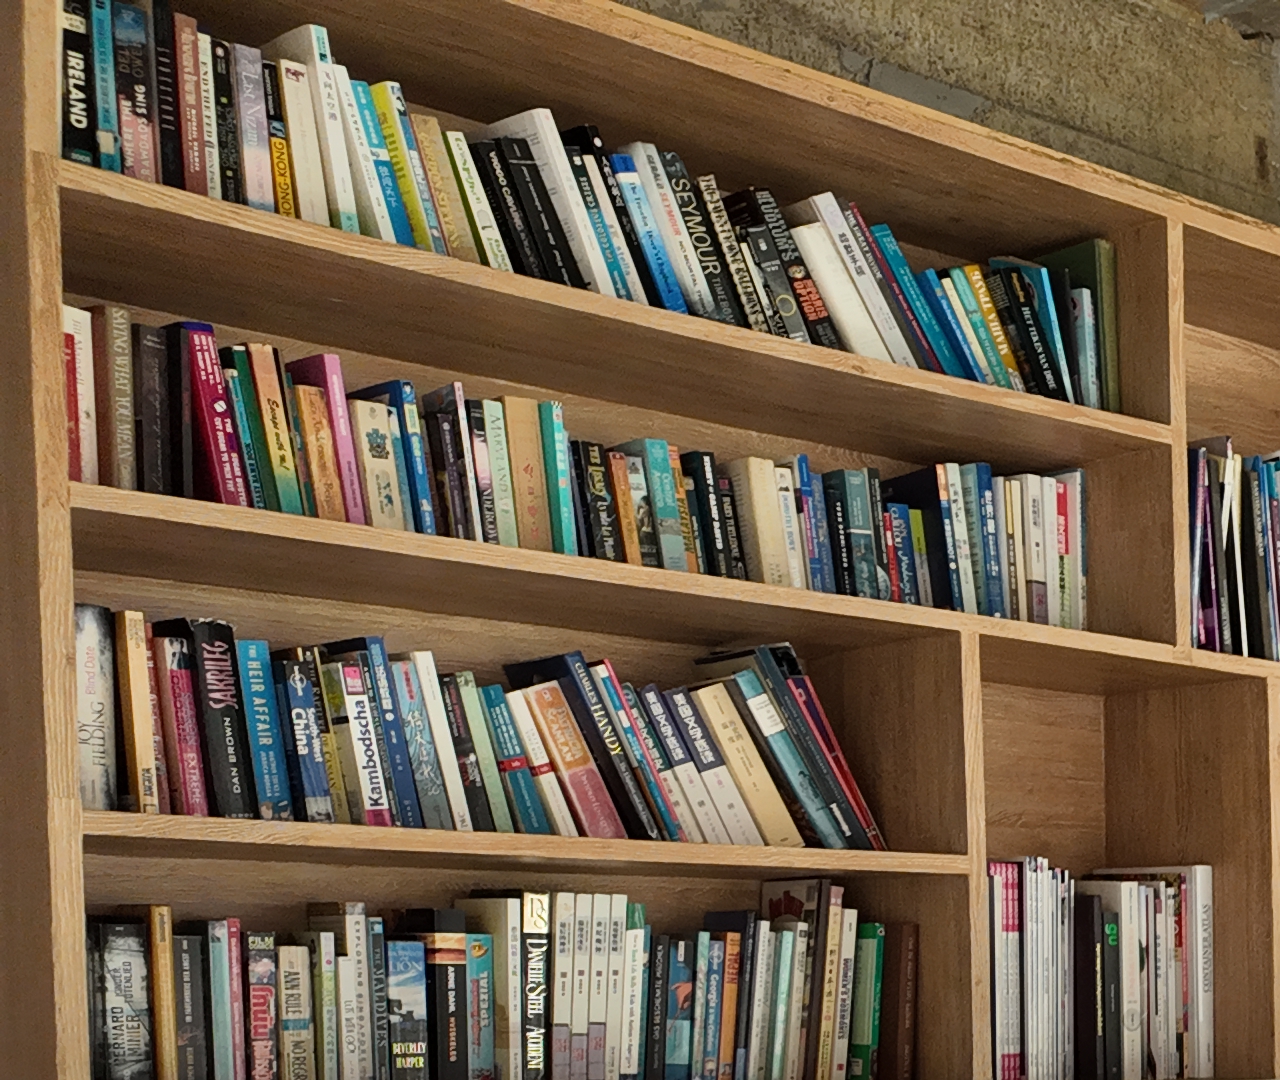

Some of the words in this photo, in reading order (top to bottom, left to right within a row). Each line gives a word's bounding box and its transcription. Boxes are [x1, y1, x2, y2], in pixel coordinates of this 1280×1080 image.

[67, 50, 87, 128] IRELAND
[200, 61, 210, 86] END
[242, 72, 258, 98] Last
[120, 99, 132, 120] THE
[134, 84, 147, 114] SING
[202, 87, 212, 113] THE
[204, 115, 213, 139] FED
[121, 126, 134, 167] WHERE
[274, 141, 293, 218] HONG-KONG
[489, 151, 506, 185] VIGGO
[419, 132, 445, 191] GORDON
[436, 191, 461, 248] STEVENS
[646, 154, 665, 189] GERALD
[659, 192, 682, 236] SEYMOUR
[671, 178, 721, 274] SEYMOUR
[793, 281, 819, 321] OPTION
[806, 287, 828, 319] PARIS
[1020, 307, 1034, 324] HET
[71, 319, 84, 335] Jill
[112, 308, 130, 352] SAYING
[1027, 326, 1043, 353] TEKEN
[114, 356, 130, 393] WHAT
[1038, 353, 1051, 369] VAN
[1043, 370, 1057, 390] DRIE
[116, 397, 131, 420] YOU
[267, 398, 279, 431] Escape
[117, 422, 132, 459] MEAN
[216, 431, 227, 451] SUGAR
[489, 415, 509, 493] MARYLAND
[588, 446, 600, 463] THE
[231, 453, 242, 476] SUGAR
[703, 456, 714, 485] NIGHT
[651, 470, 664, 507] America
[662, 473, 675, 506] Central
[480, 480, 498, 544] UNDERCOV
[708, 494, 719, 520] CAMP
[677, 498, 694, 553] MALAYSIA
[713, 522, 724, 550] DAVID
[898, 551, 914, 593] Madame
[85, 646, 95, 668] Date
[85, 670, 96, 695] Blind
[201, 641, 239, 710] SAKRILEG
[181, 693, 196, 746] SHARON
[247, 661, 264, 692] HEIR
[257, 697, 273, 746] AFFAIR
[575, 662, 596, 704] CHARLES
[591, 704, 623, 756] HANDY
[78, 721, 93, 745] JOY
[82, 701, 106, 767] FIELDING
[223, 717, 237, 763] BROWN
[291, 708, 309, 755] China
[307, 708, 324, 763] South-West
[545, 708, 573, 762] SCANLAN
[324, 751, 337, 790] CANAAN
[354, 700, 385, 808] Kambodscha
[142, 767, 154, 797] ANGKOR
[186, 753, 202, 804] EXTREME
[231, 767, 241, 794] DAN
[1105, 923, 1118, 946] gu
[1202, 904, 1211, 936] ATLAS
[355, 920, 364, 987] EXPLORING
[526, 939, 548, 984] DANIELLE
[726, 952, 740, 984] NEPAL
[1202, 937, 1212, 993] CONTAINER
[284, 971, 300, 990] ANN
[447, 966, 456, 989] ARNE
[708, 974, 719, 1006] Georgia
[285, 994, 302, 1015] RULE
[374, 968, 387, 1047] MALDIVES
[448, 991, 456, 1013] DAHL
[479, 971, 490, 1027] SPEZIAL
[526, 984, 548, 1018] STEEL
[111, 1007, 125, 1067] BERNARD
[126, 1015, 142, 1058] MINIER
[292, 1041, 305, 1054] NO
[526, 1026, 546, 1071] ACCIDENT
